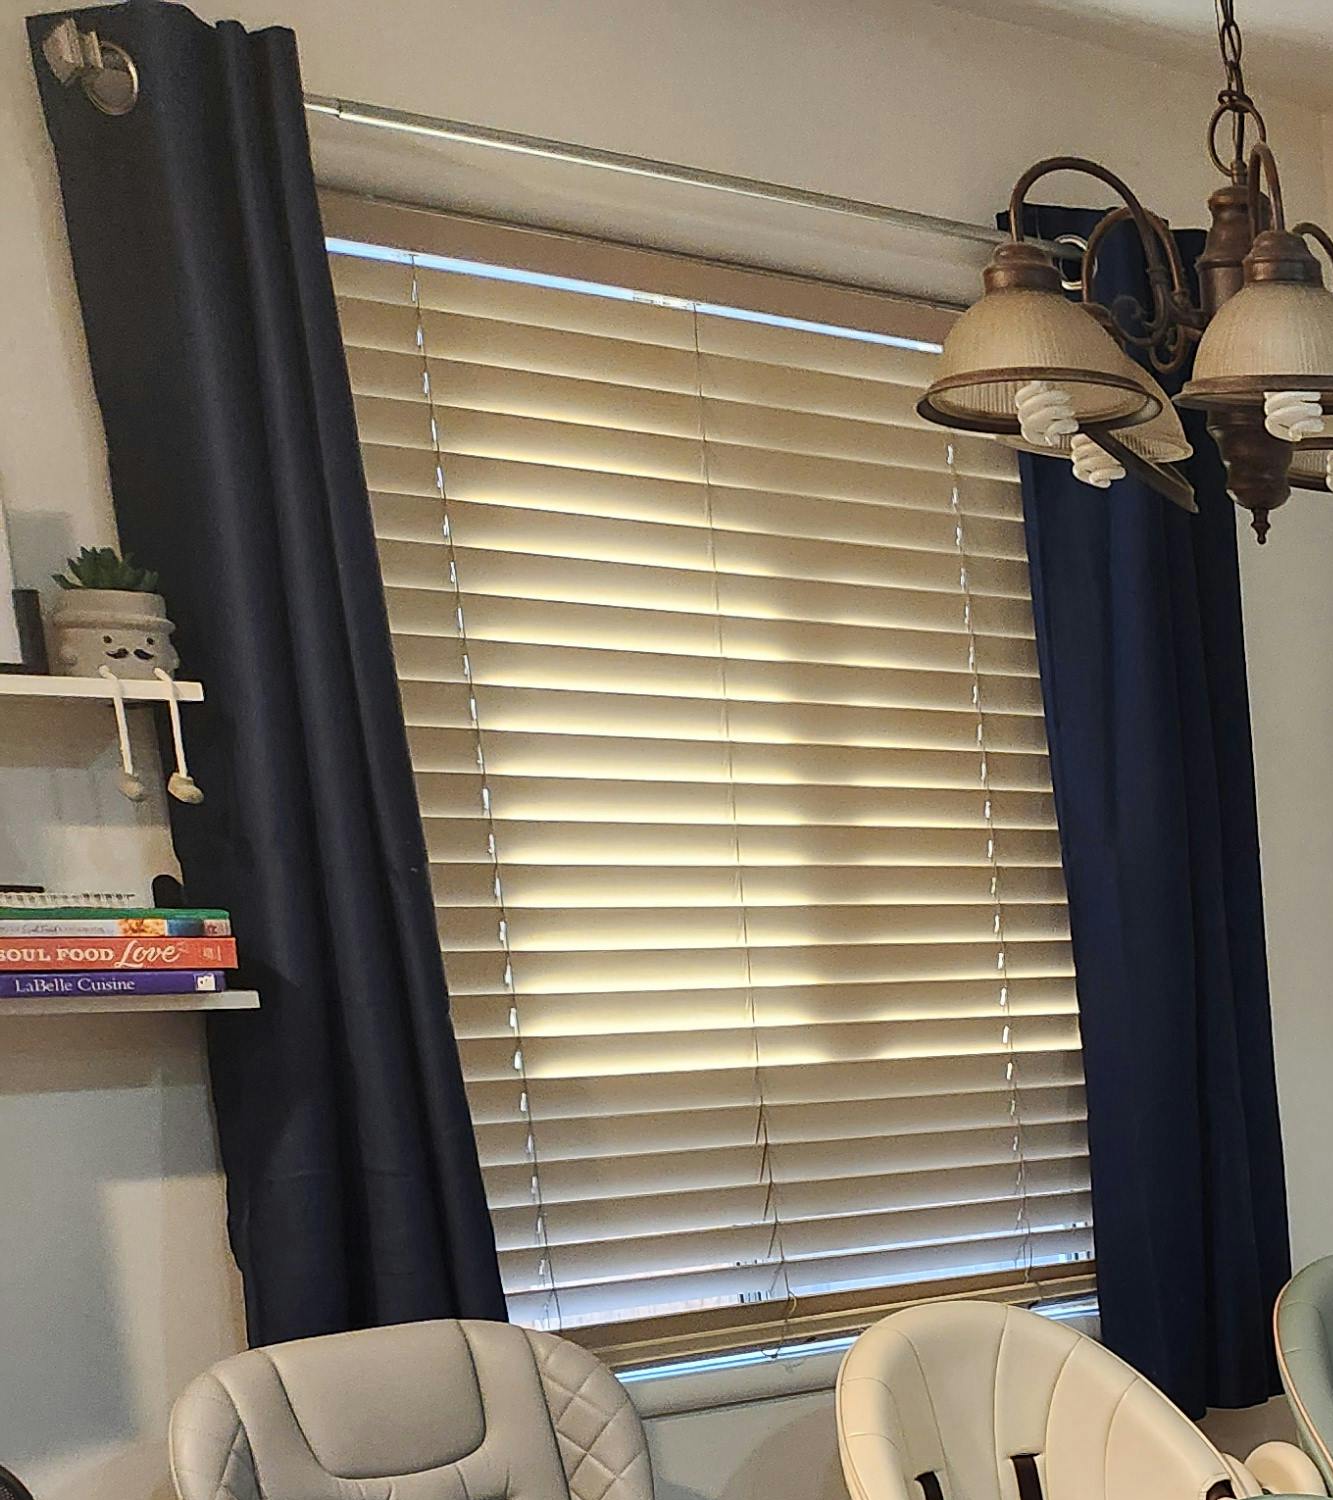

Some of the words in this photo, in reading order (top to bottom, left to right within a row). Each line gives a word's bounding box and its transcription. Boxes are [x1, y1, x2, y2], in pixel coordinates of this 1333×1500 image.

[56, 948, 114, 961] FOOD
[114, 940, 180, 968] Love
[15, 978, 72, 993] LaBelle
[77, 977, 135, 992] Cuisine
